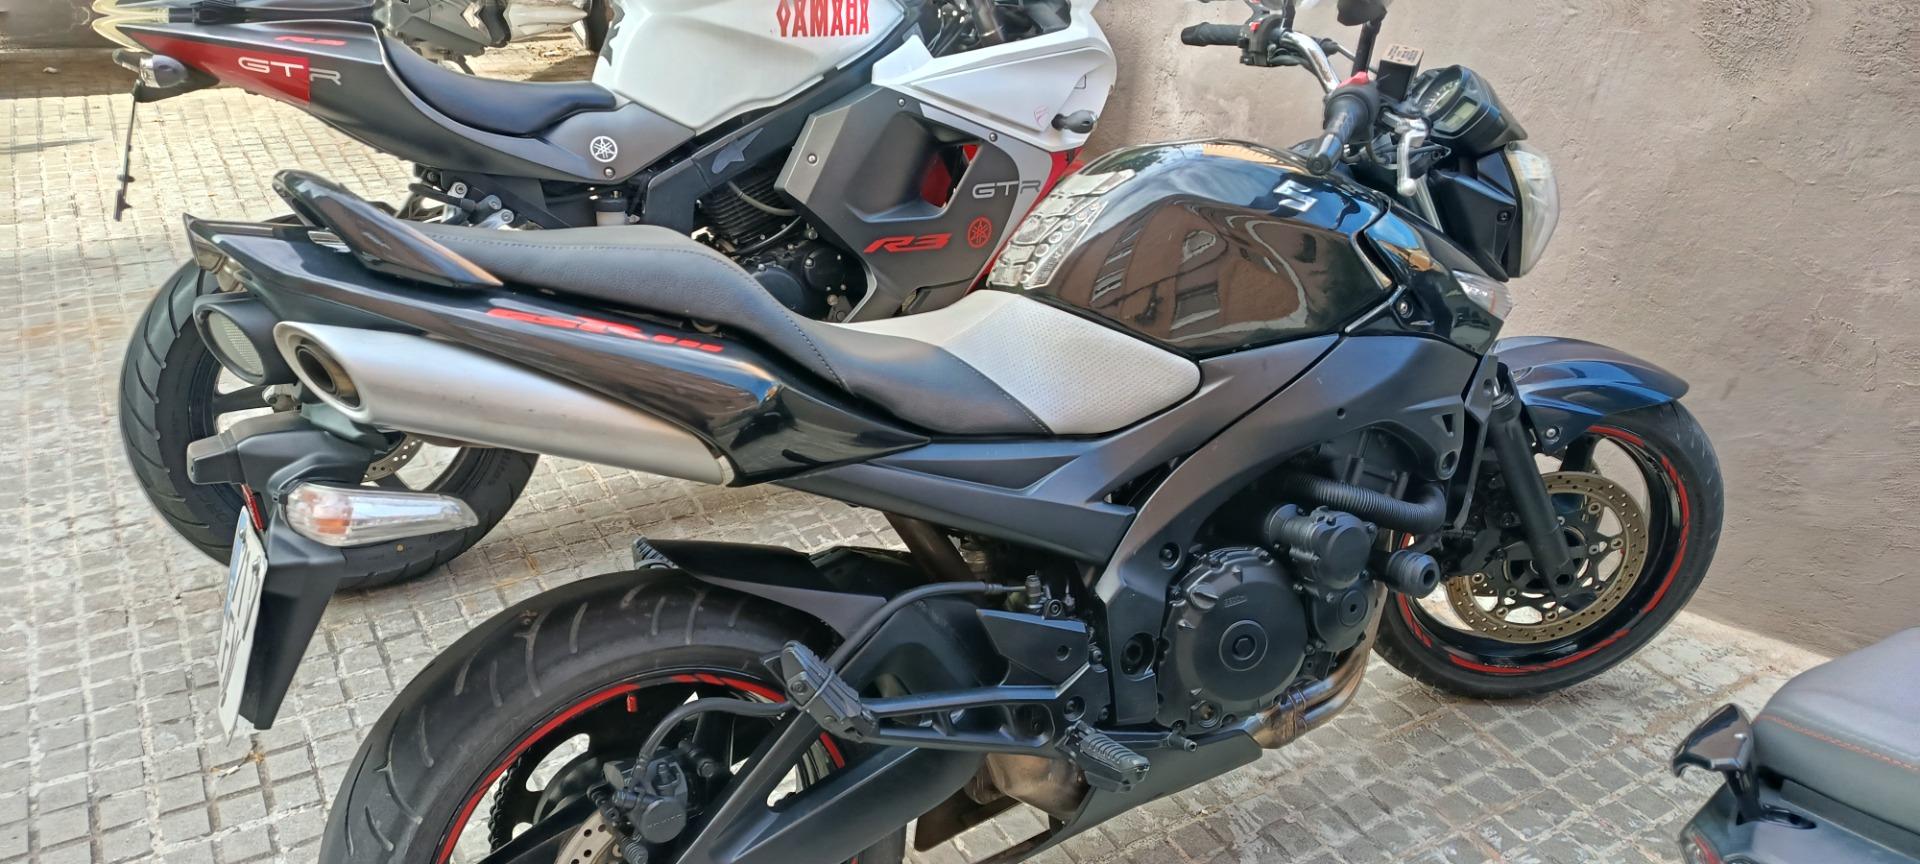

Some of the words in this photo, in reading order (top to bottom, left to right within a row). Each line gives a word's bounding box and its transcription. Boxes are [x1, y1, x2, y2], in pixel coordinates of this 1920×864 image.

[776, 0, 869, 37] YAMAHA
[238, 56, 341, 85] GTR
[972, 180, 1041, 199] GTR
[863, 233, 952, 254] R3
